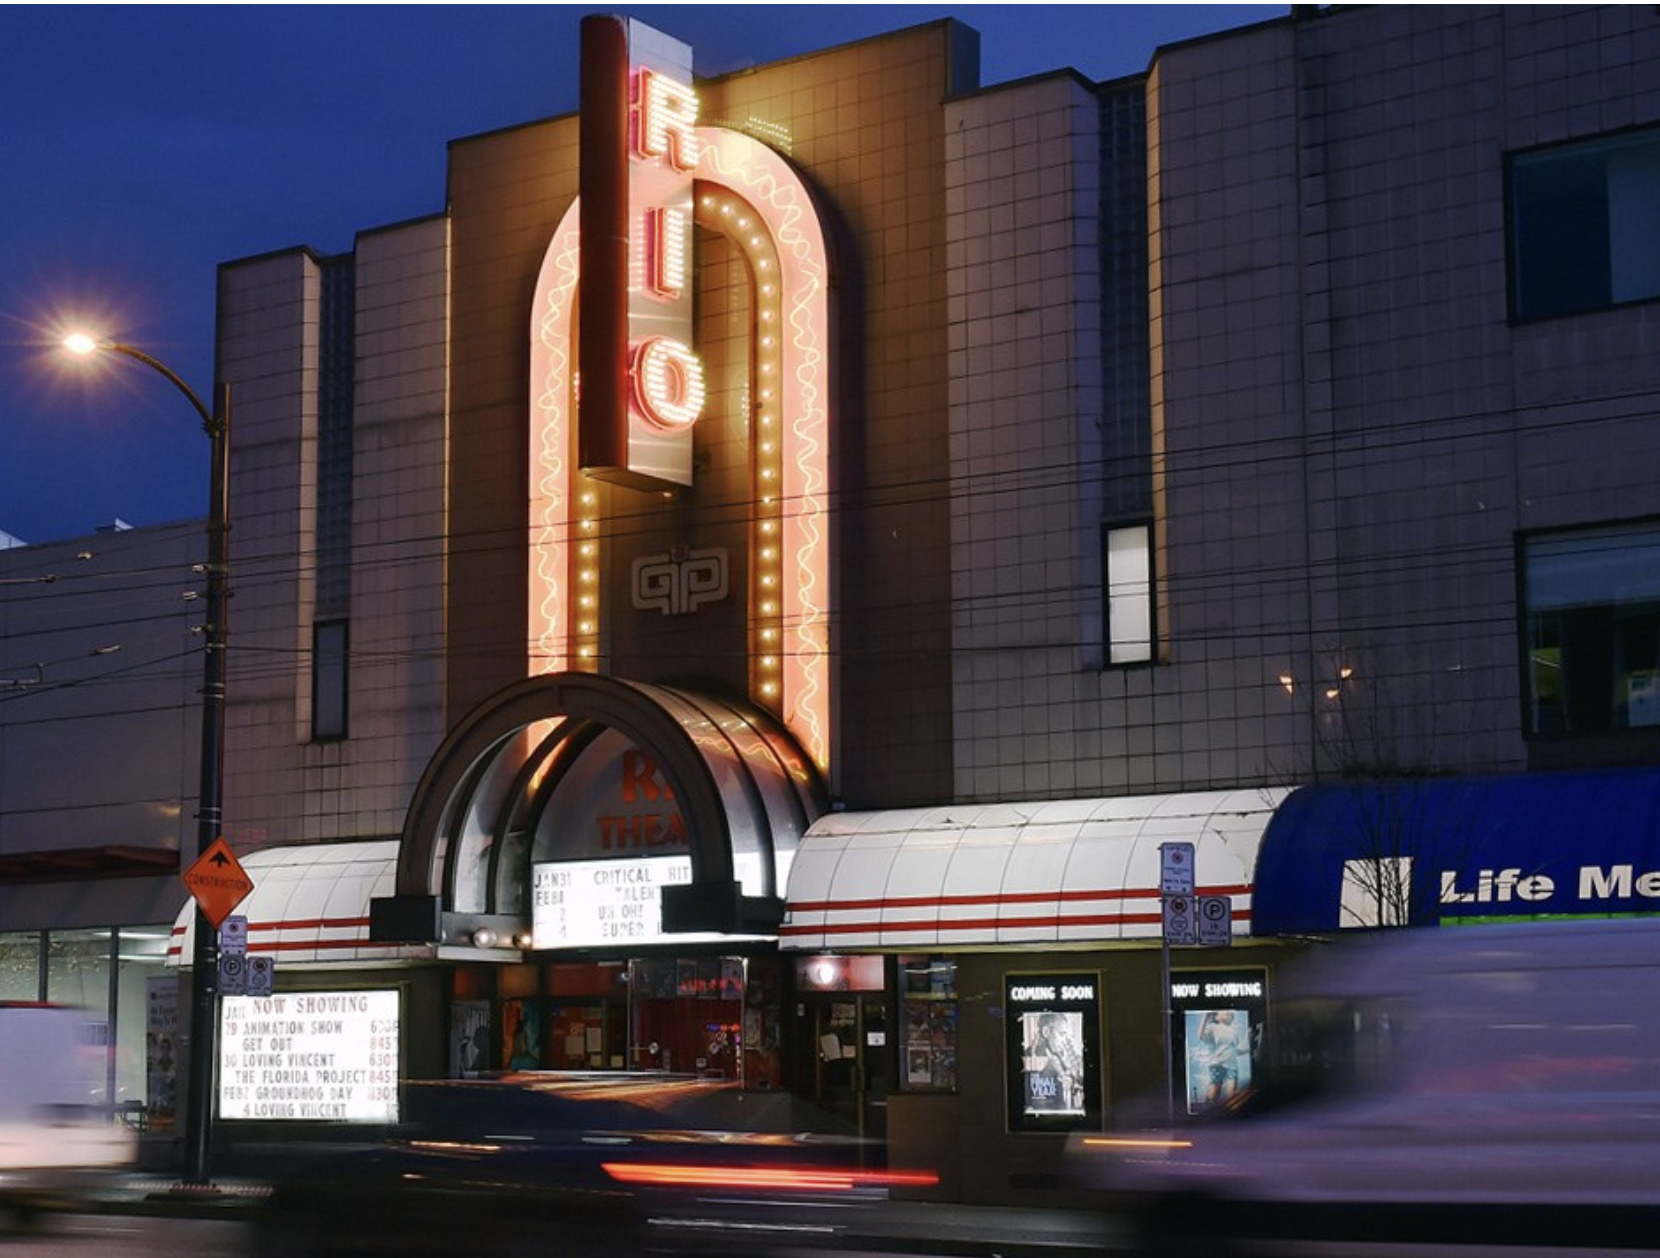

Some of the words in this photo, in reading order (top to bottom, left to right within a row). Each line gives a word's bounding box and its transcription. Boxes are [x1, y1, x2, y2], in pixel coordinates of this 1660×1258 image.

[628, 64, 705, 432] RIO
[622, 750, 675, 803] R
[593, 867, 652, 886] CRITICAL
[667, 865, 690, 881] HIT
[1440, 869, 1555, 904] Life
[1579, 864, 1660, 900] Me
[1011, 986, 1056, 1000] COMING
[1061, 985, 1094, 1000] SOON
[1172, 984, 1199, 998] NOW
[1205, 982, 1262, 998] SHOWING
[252, 998, 286, 1015] NOW
[297, 996, 369, 1014] SHOWING
[243, 1021, 305, 1035] ANIMATION
[310, 1020, 344, 1035] SHOW
[242, 1038, 263, 1052] GET
[270, 1037, 293, 1052] OUT
[242, 1053, 283, 1068] LOVING
[287, 1053, 335, 1068] VINCENT
[235, 1070, 255, 1084] THE
[263, 1070, 310, 1084] FLORIDA
[316, 1069, 367, 1084] PROJECT
[256, 1086, 325, 1101] GROUNDHOG
[330, 1086, 354, 1101] DAY
[254, 1103, 295, 1118] LOVING
[298, 1103, 348, 1118] VINCENT
